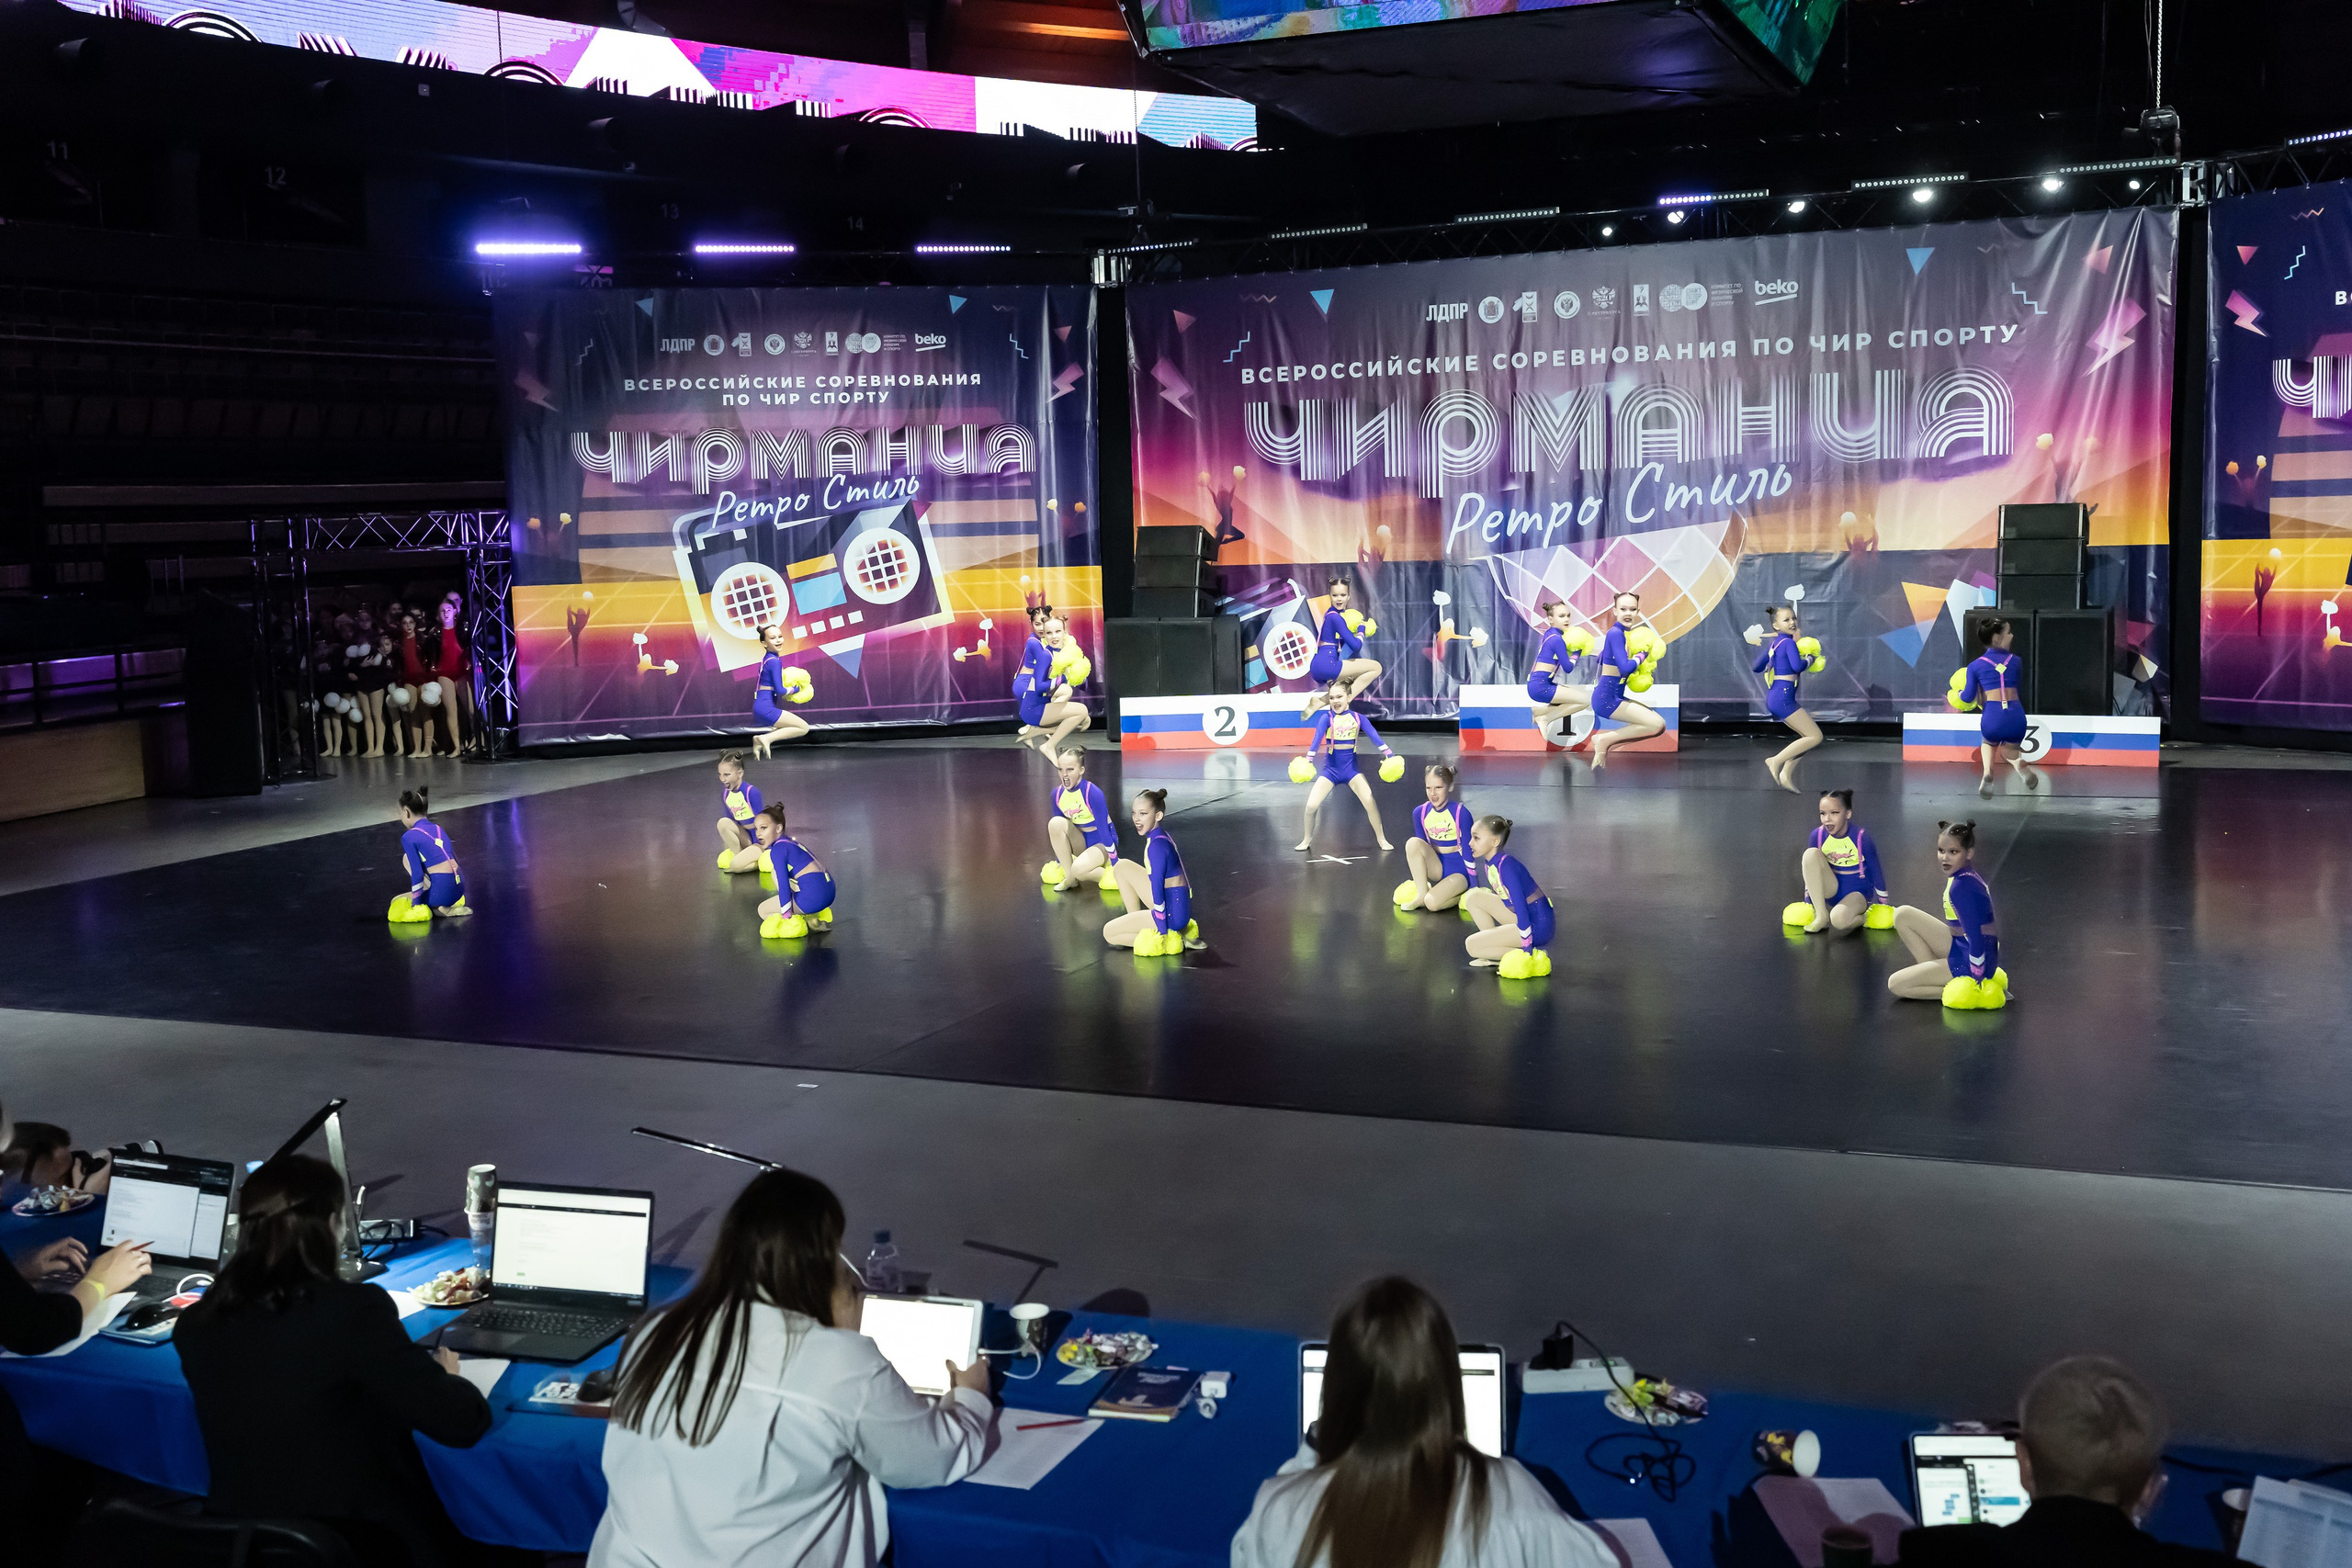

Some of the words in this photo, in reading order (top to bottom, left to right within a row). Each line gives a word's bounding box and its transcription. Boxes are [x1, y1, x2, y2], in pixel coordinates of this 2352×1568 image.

[47, 139, 68, 160] 11
[265, 166, 287, 186] 12
[661, 203, 680, 220] 13
[847, 215, 864, 231] 14
[1754, 278, 1799, 297] beko
[1426, 302, 1469, 323] ЛДПР
[660, 338, 695, 354] ЛДПР
[915, 333, 947, 345] beko
[1241, 354, 1479, 385] ВСЕРОССИЙСКИЕ
[1492, 340, 1737, 370] СОРЕВНОВАНИЯ
[1753, 336, 1794, 356] ПО
[1810, 332, 1872, 353] ЧИР
[1887, 324, 2019, 349] СПОРТУ
[624, 374, 807, 391] ВСЕРОССИЙСКИЕ
[816, 373, 982, 389] СОРЕВНОВАНИЯ
[722, 393, 751, 407] ПО
[760, 392, 800, 406] ЧИР
[809, 390, 890, 405] СПОРТУ
[712, 491, 810, 529] Ретро
[823, 473, 920, 511] Стиль
[1445, 491, 1604, 554] Ретро
[1624, 461, 1792, 524] Стиль
[1214, 705, 1237, 737] 2
[2019, 725, 2040, 754] 3
